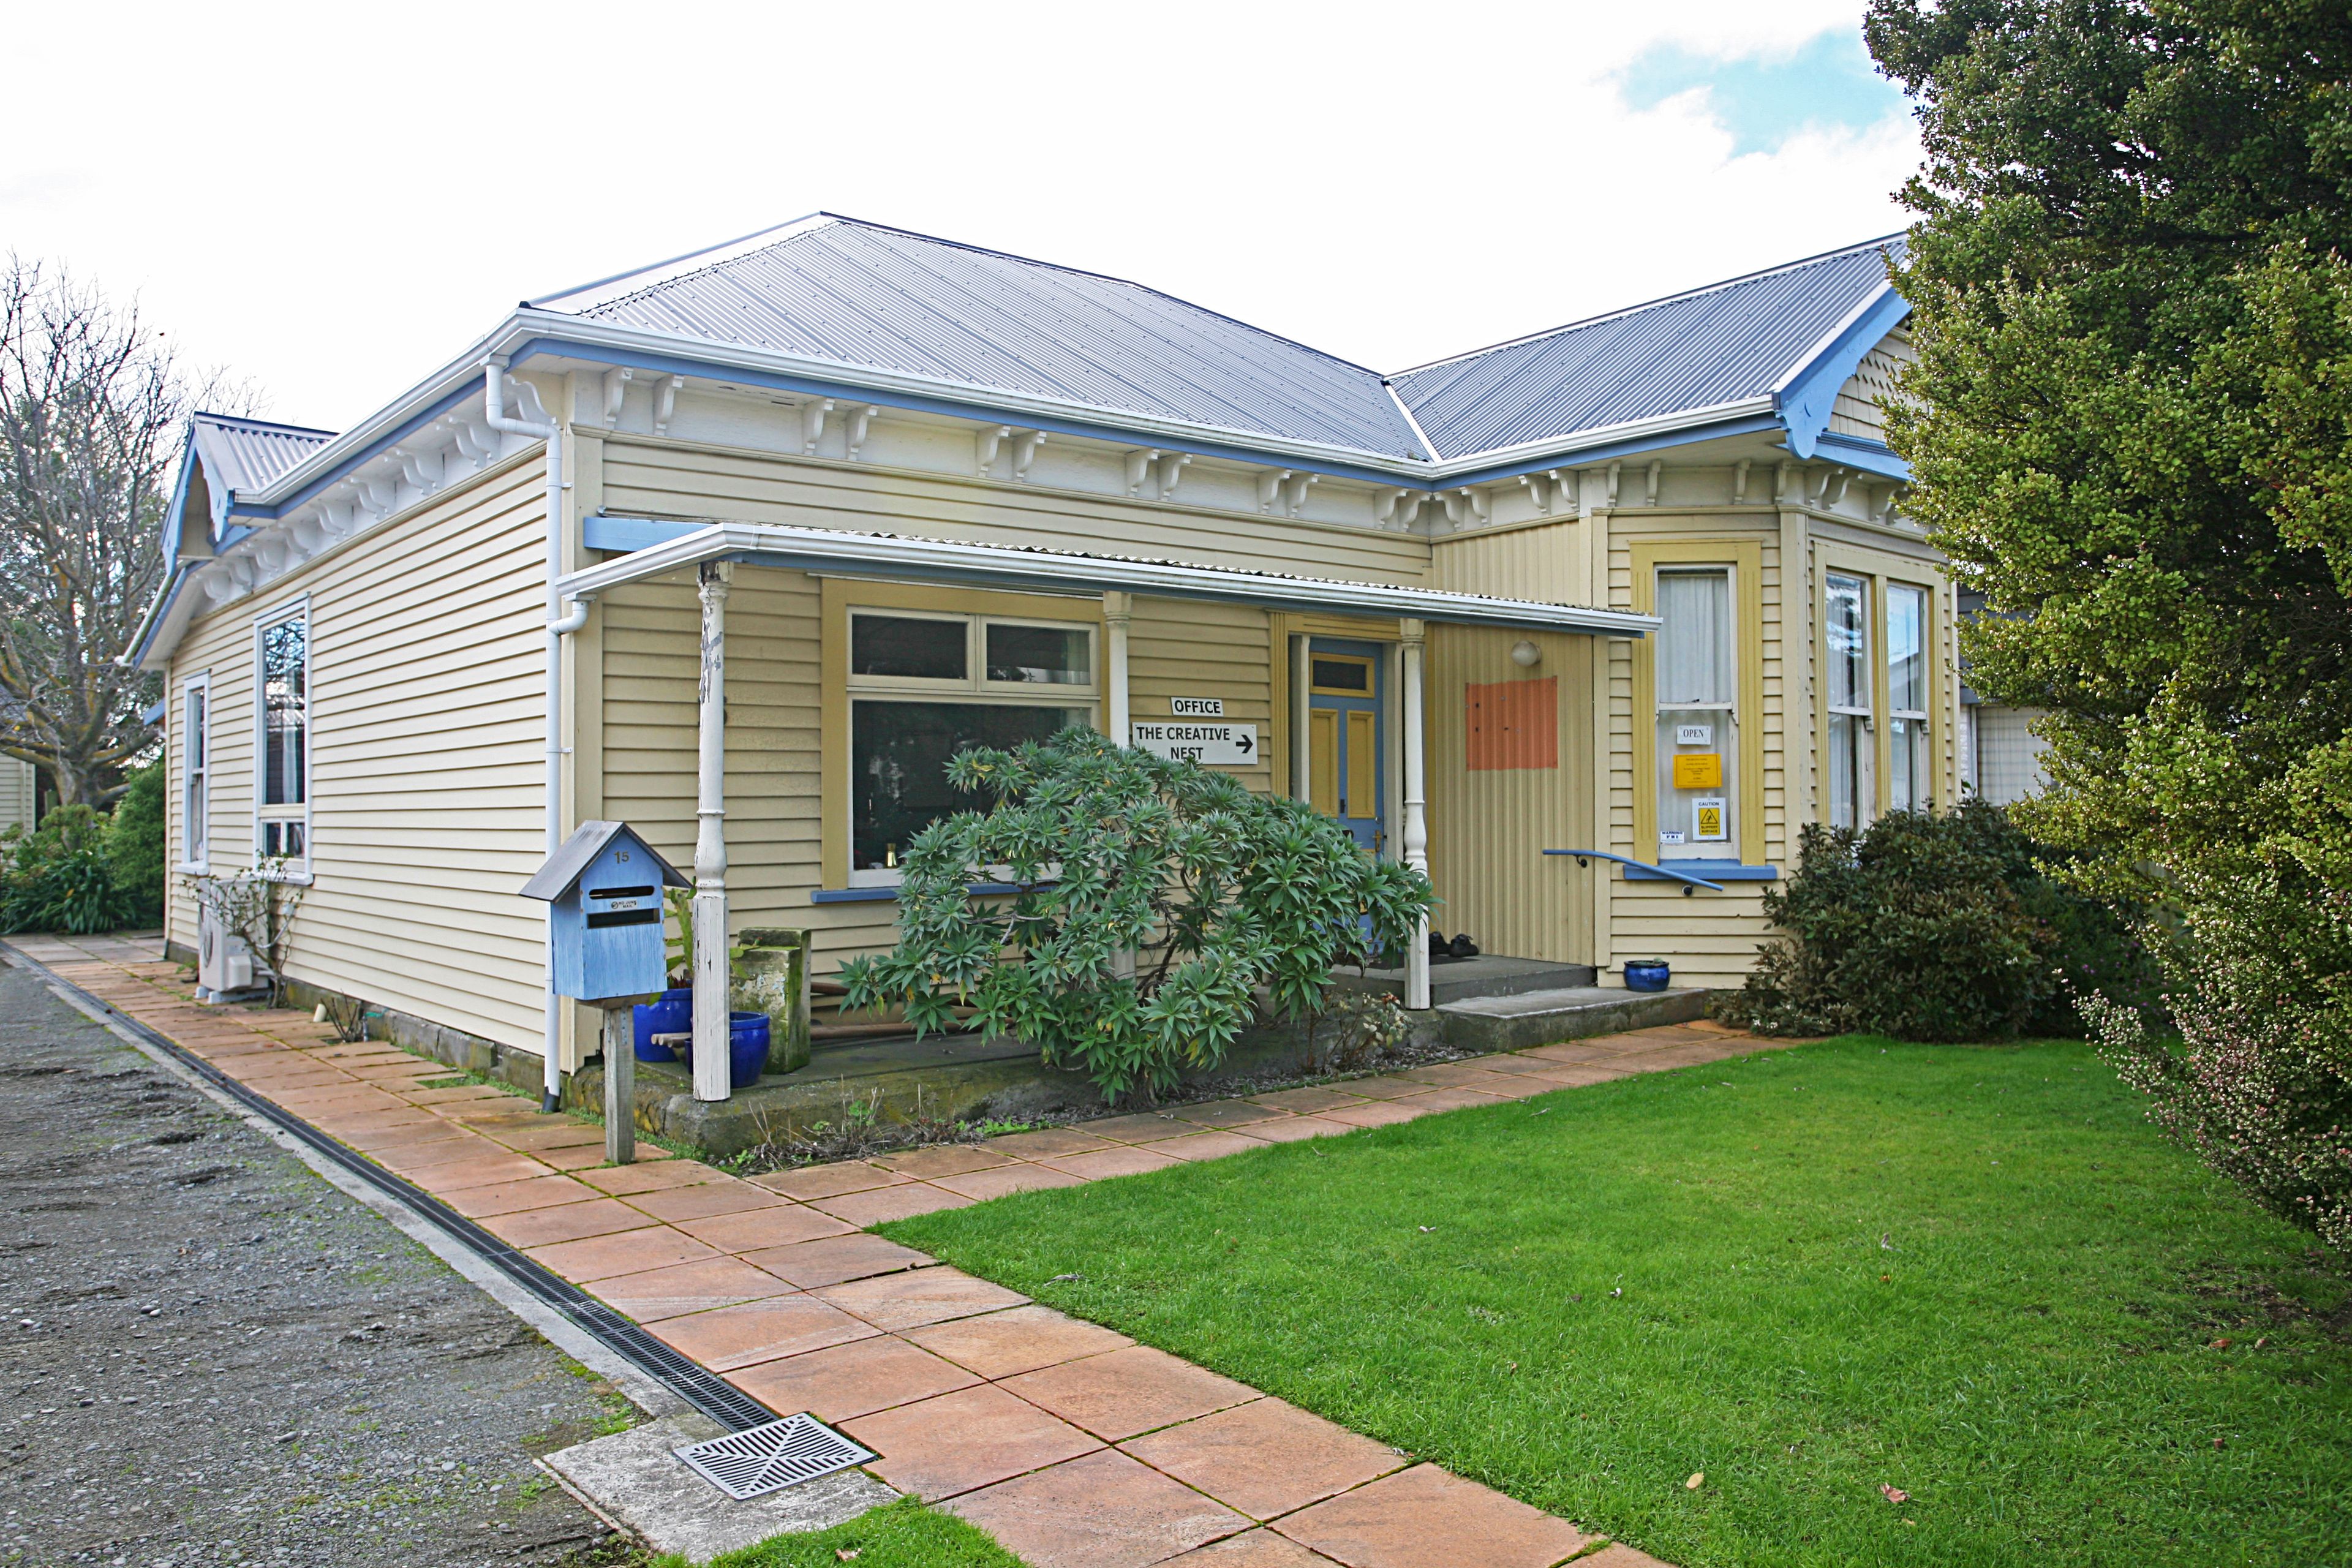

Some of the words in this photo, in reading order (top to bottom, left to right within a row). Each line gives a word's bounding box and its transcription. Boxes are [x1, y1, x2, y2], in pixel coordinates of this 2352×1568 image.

[1174, 699, 1221, 714] OFFICE
[1136, 726, 1163, 740] THE
[1166, 727, 1230, 741] CREATIVE
[1683, 729, 1704, 738] OPEN
[1170, 747, 1204, 760] NEST
[614, 851, 629, 864] 15
